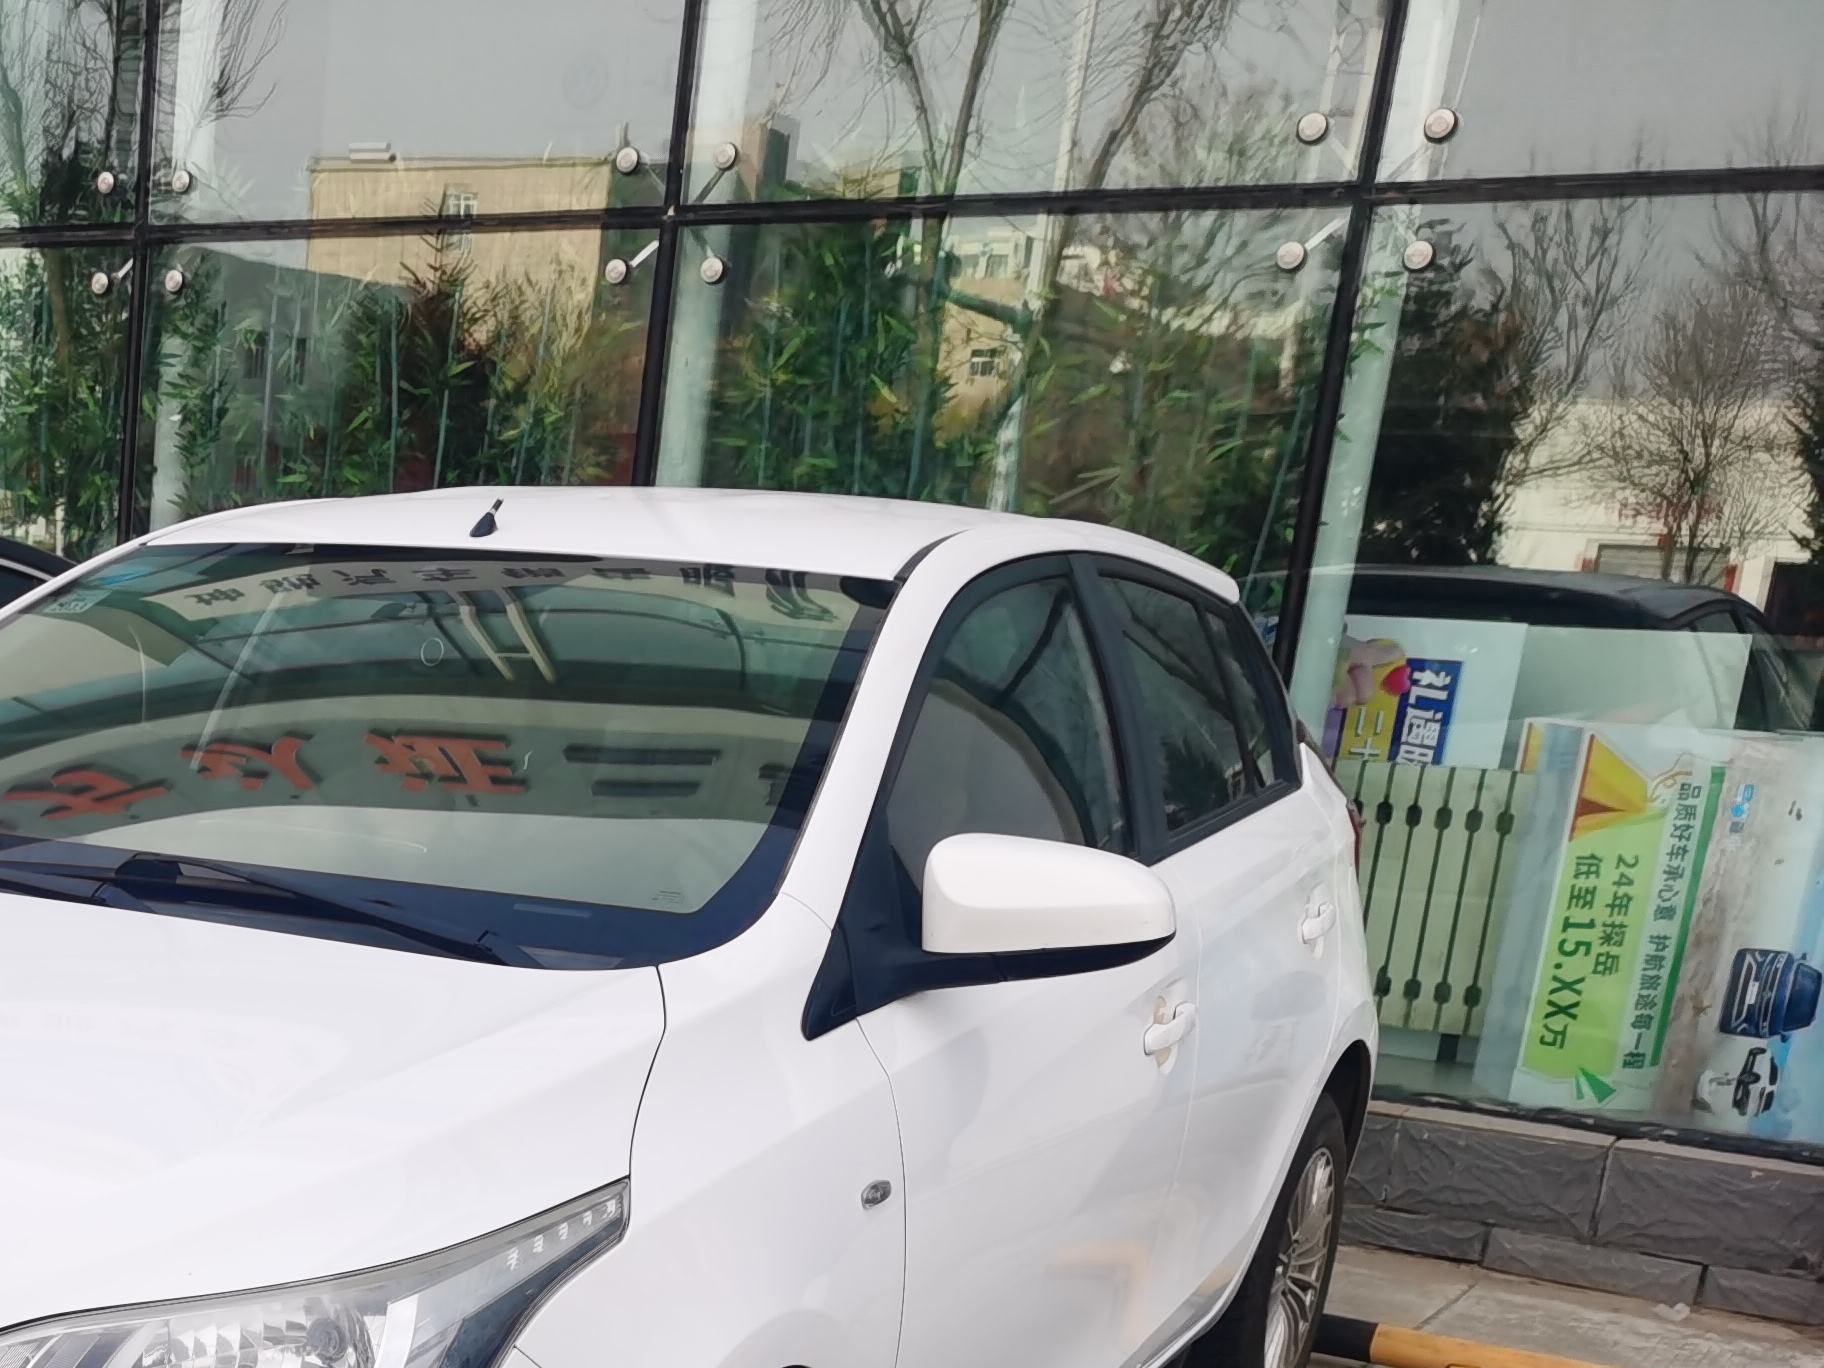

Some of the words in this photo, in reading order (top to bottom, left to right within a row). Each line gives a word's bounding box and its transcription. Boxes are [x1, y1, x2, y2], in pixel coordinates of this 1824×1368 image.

[1592, 854, 1640, 977] 24年探岳
[1652, 782, 1701, 922] 品质好车承心意
[1538, 852, 1603, 1050] 低至15.XX万
